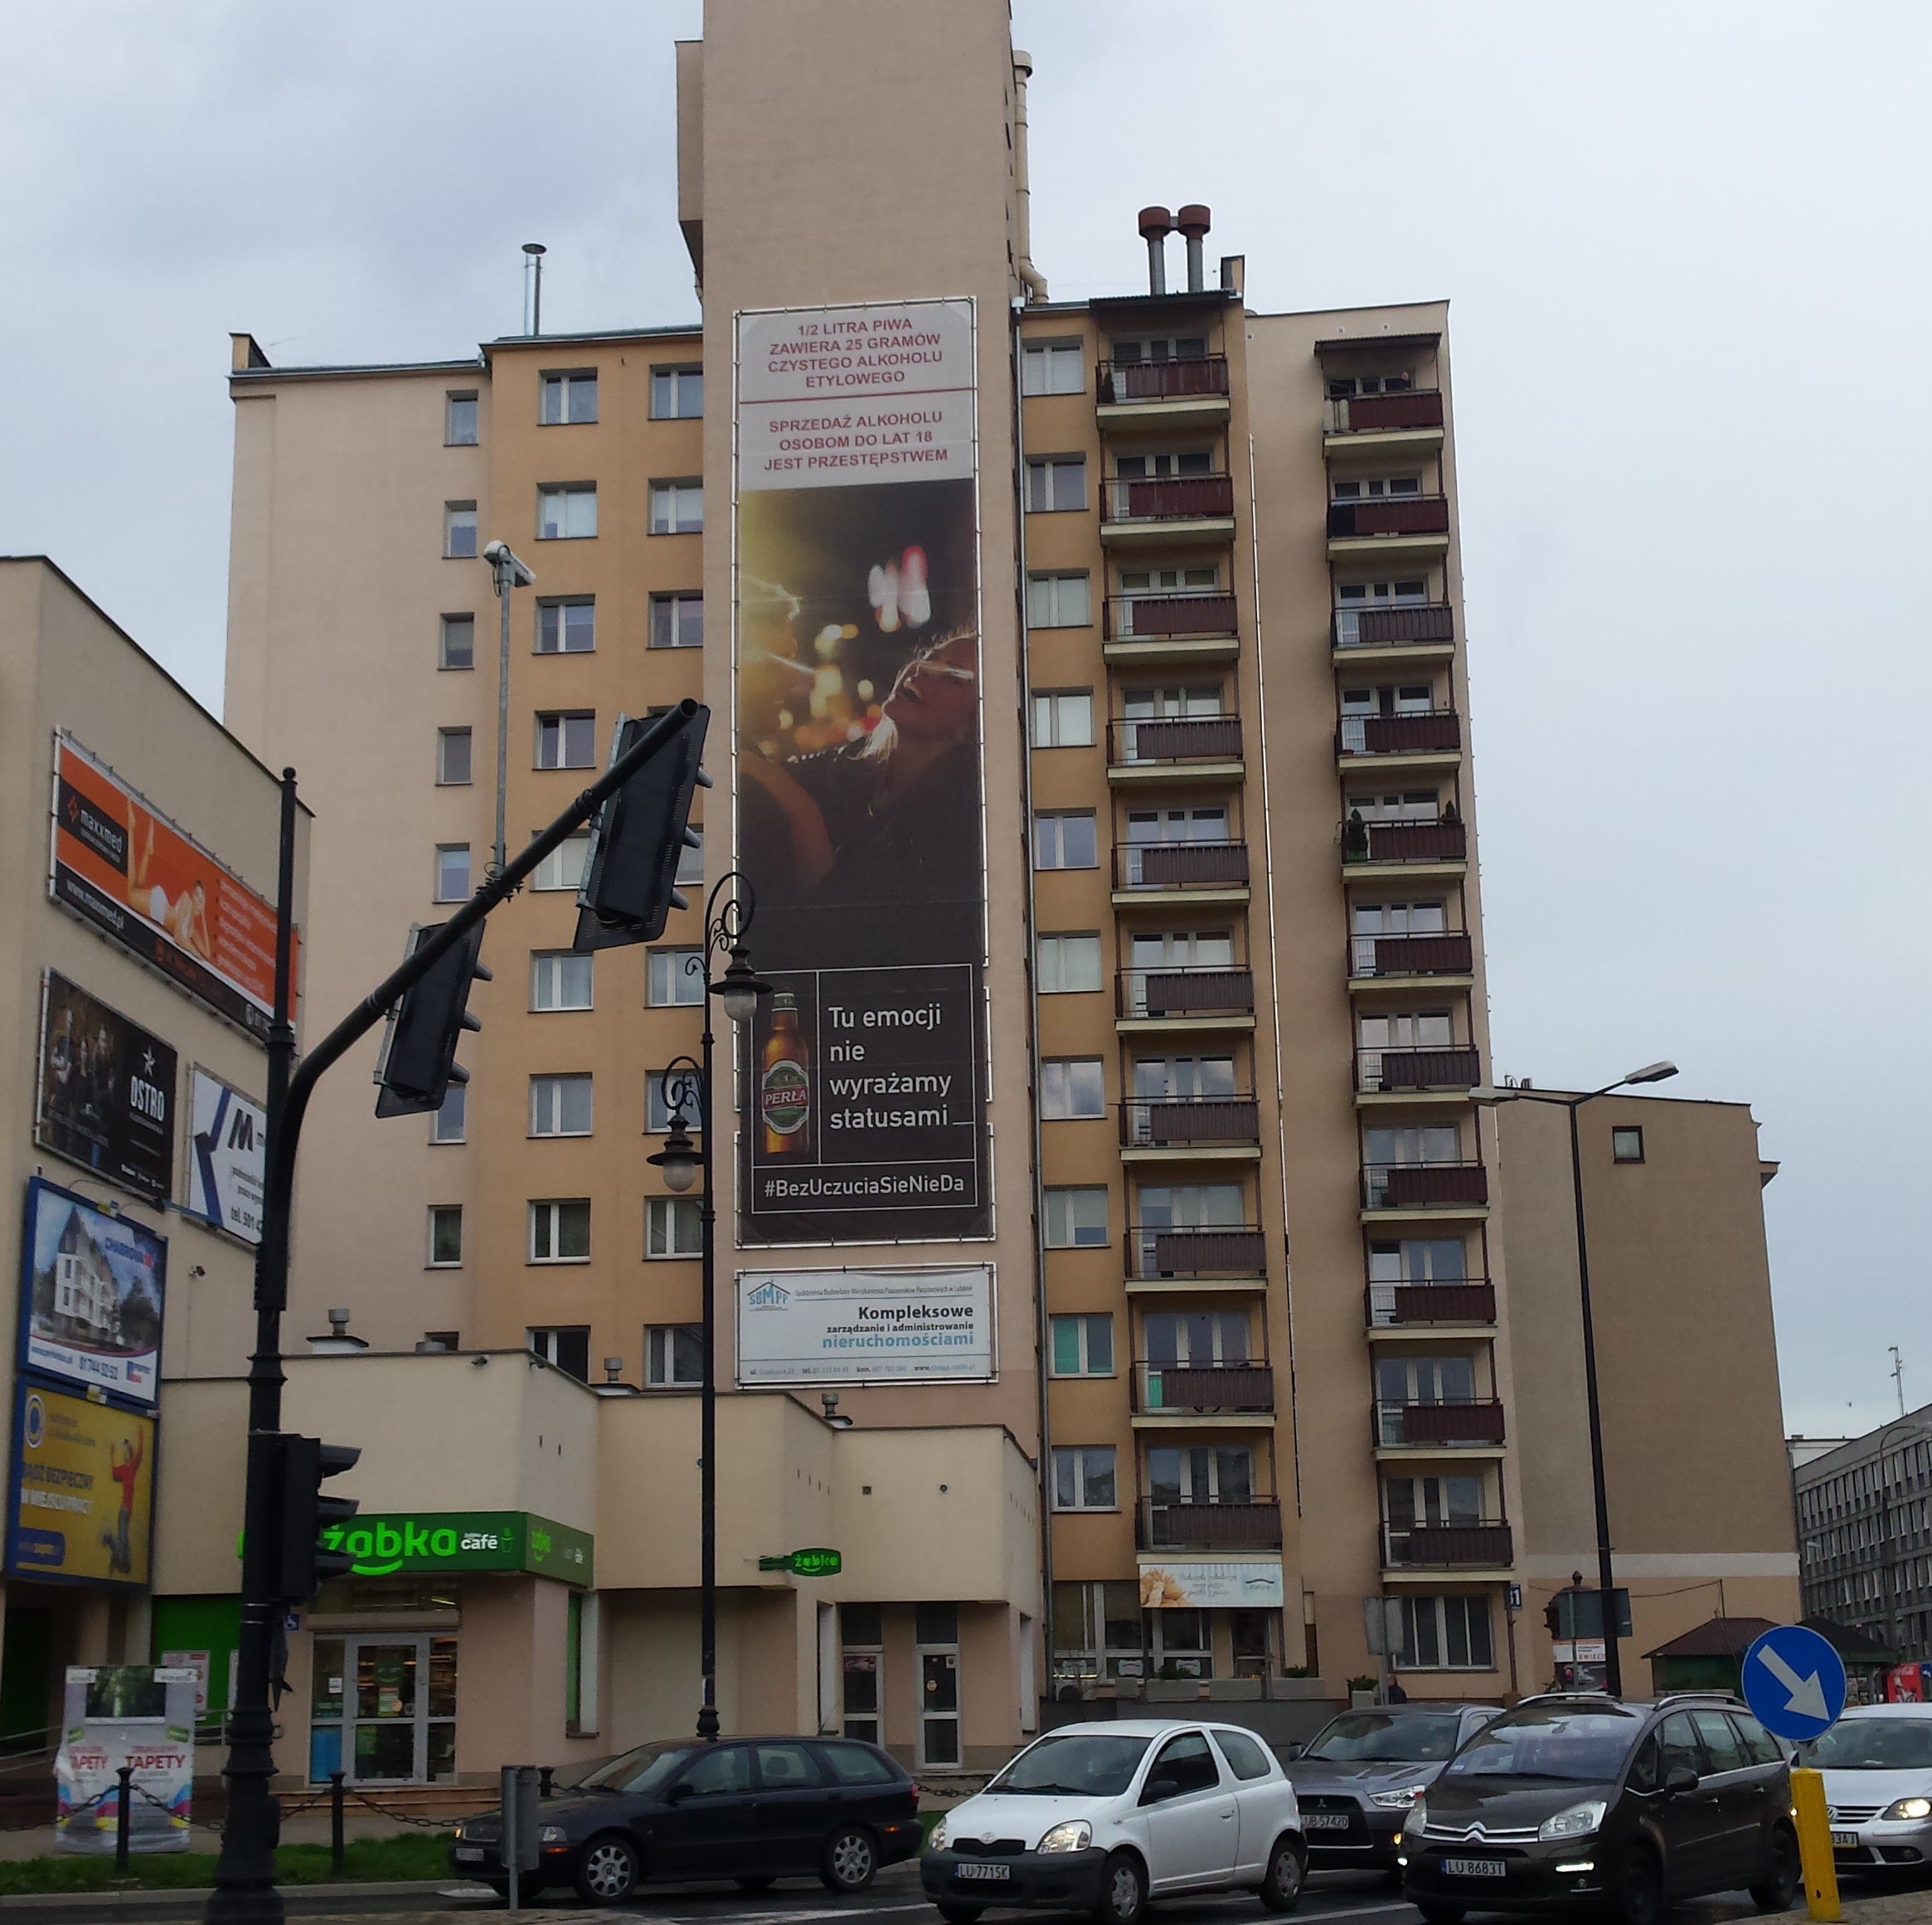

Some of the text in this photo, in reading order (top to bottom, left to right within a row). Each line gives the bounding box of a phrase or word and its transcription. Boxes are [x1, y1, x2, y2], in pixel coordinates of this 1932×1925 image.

[798, 318, 913, 337] 1/2 LITRA PIWA
[769, 332, 941, 355] ZAWIERA 25 GRAMÓW
[768, 350, 943, 372] CZYSTEGO ALKOHOLU
[805, 371, 905, 388] ETYLOWEGO
[769, 411, 943, 433] SPRZEDAŻ ALKOHOLU
[779, 430, 933, 450] OSOBOM DO LAT 18
[765, 448, 948, 471] JEST PRZESTĘPSTWEM
[828, 1002, 941, 1030] Tu emocji
[829, 1039, 866, 1062] nie
[829, 1071, 952, 1101] wyrażamy
[130, 1074, 165, 1122] OSTRO
[829, 1103, 949, 1130] statusami
[764, 1173, 964, 1198] #BezUczuciaSieNieDa
[857, 1304, 974, 1323] Kompleksowe
[827, 1321, 974, 1336] zarządzanie i administrowanie
[823, 1331, 974, 1349] nieruchomościami
[323, 1521, 457, 1558] żabka
[795, 1554, 837, 1567] żabka
[125, 1755, 187, 1769] TAPETY
[960, 1865, 1008, 1879] LU 7715K
[1449, 1861, 1503, 1874] LU 8683T
